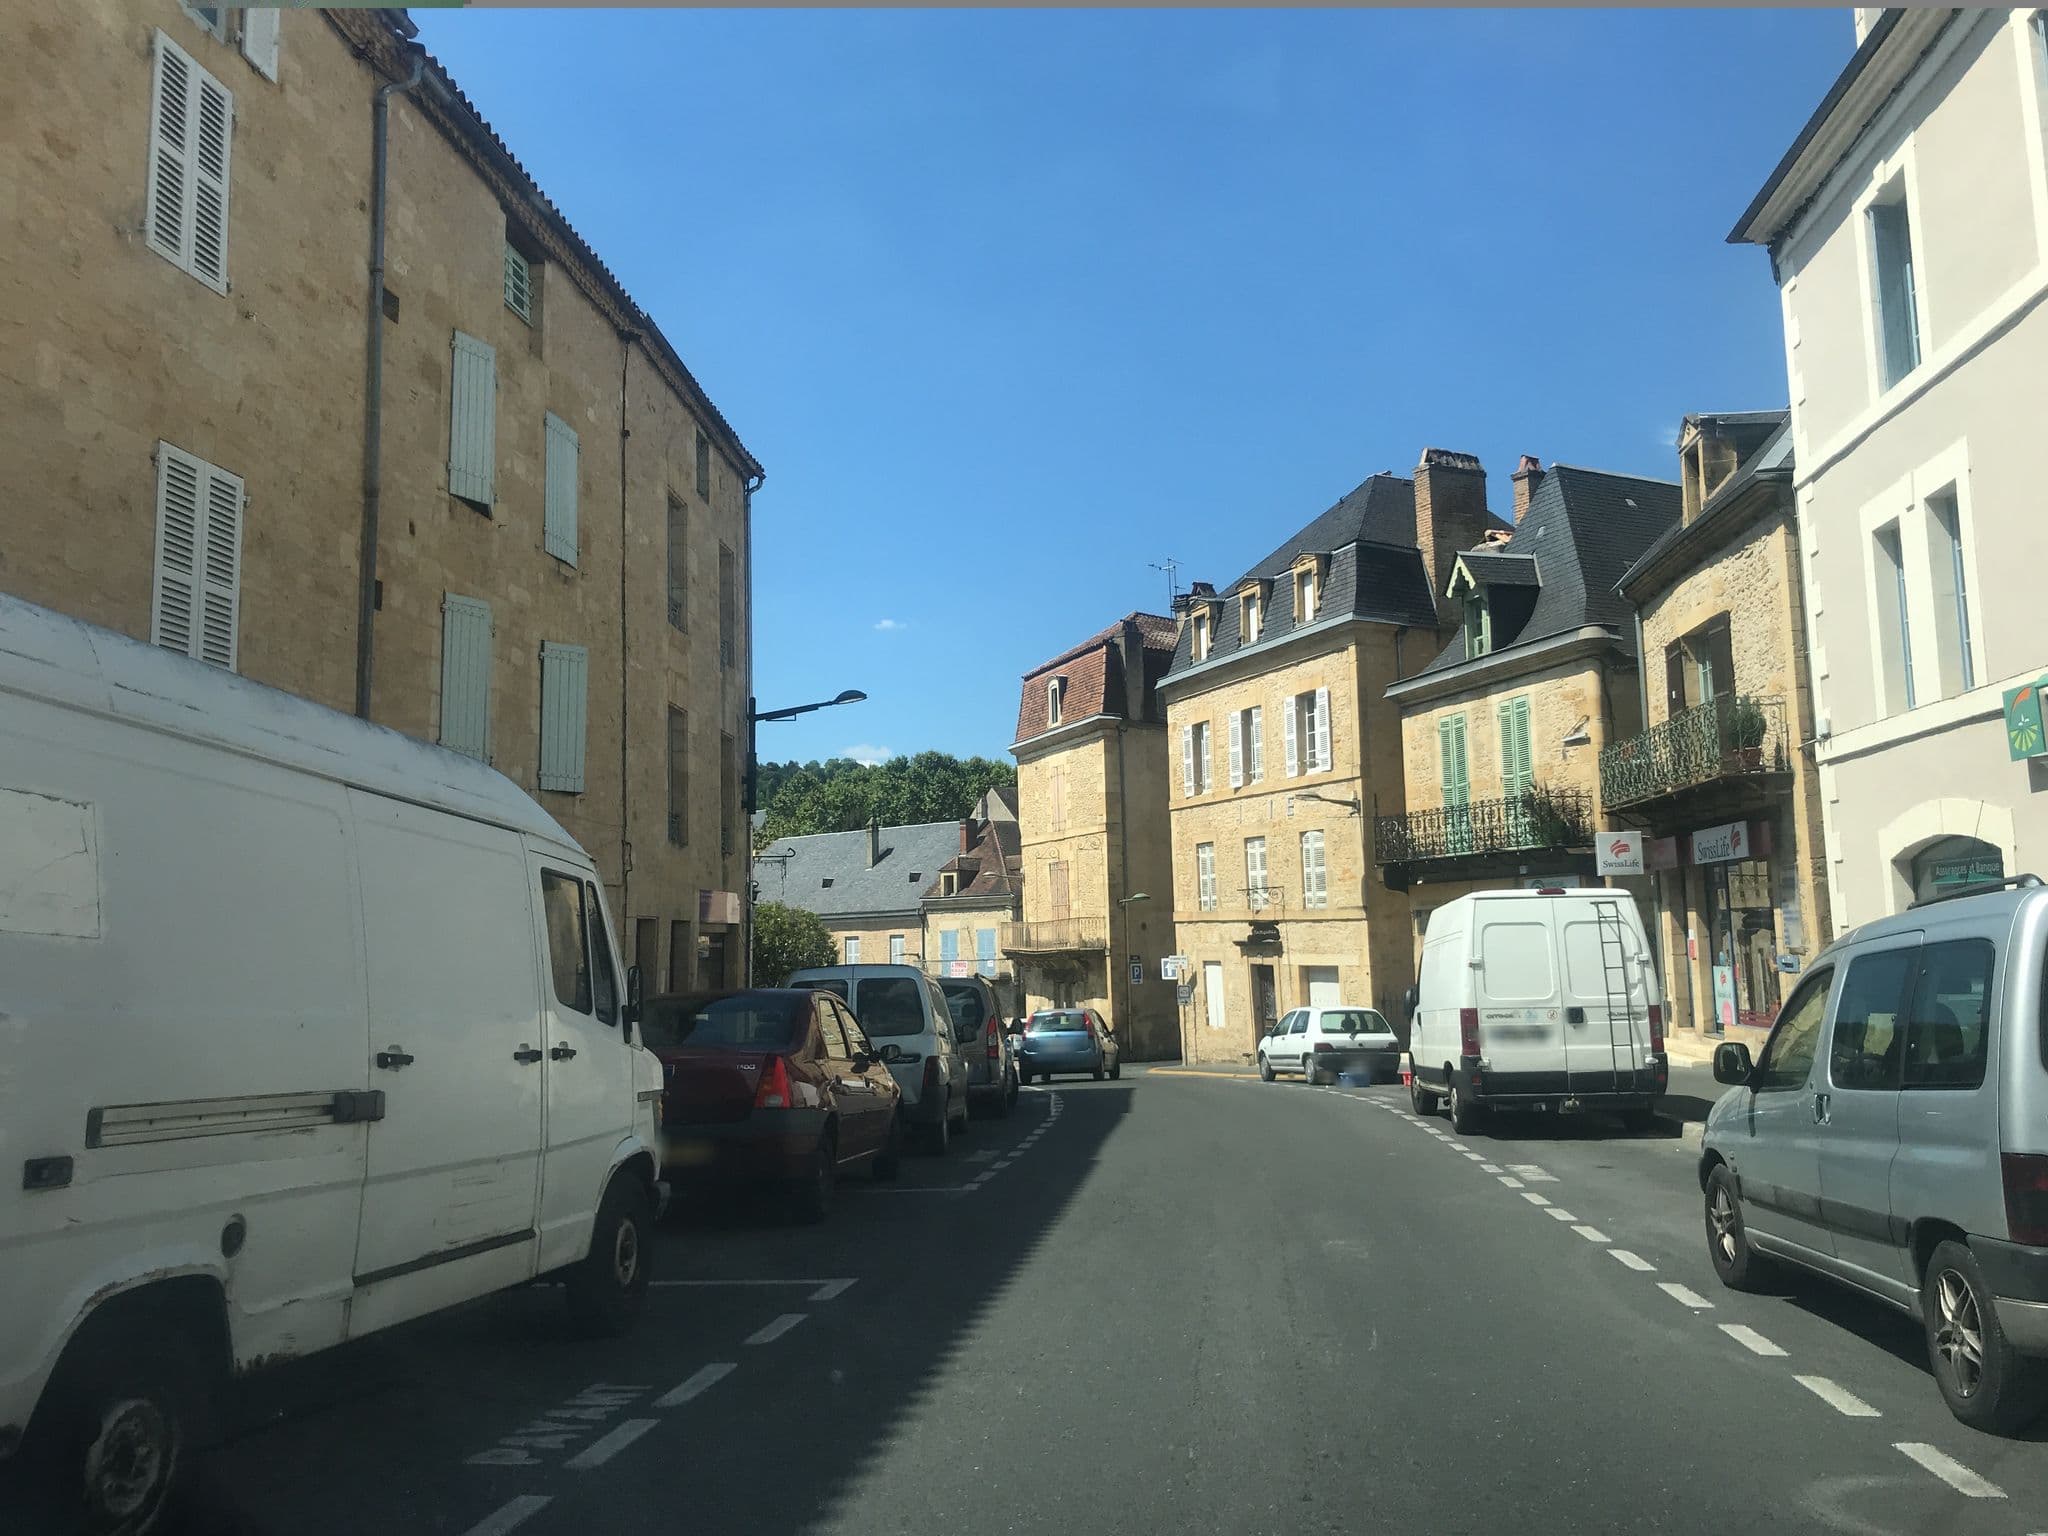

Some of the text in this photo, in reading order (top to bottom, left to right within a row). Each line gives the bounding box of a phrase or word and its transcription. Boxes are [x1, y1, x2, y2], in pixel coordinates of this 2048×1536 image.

[1698, 836, 1730, 861] SwissLife
[1602, 858, 1640, 869] SwissLife
[1975, 861, 2000, 875] Banque
[1134, 967, 1140, 977] P
